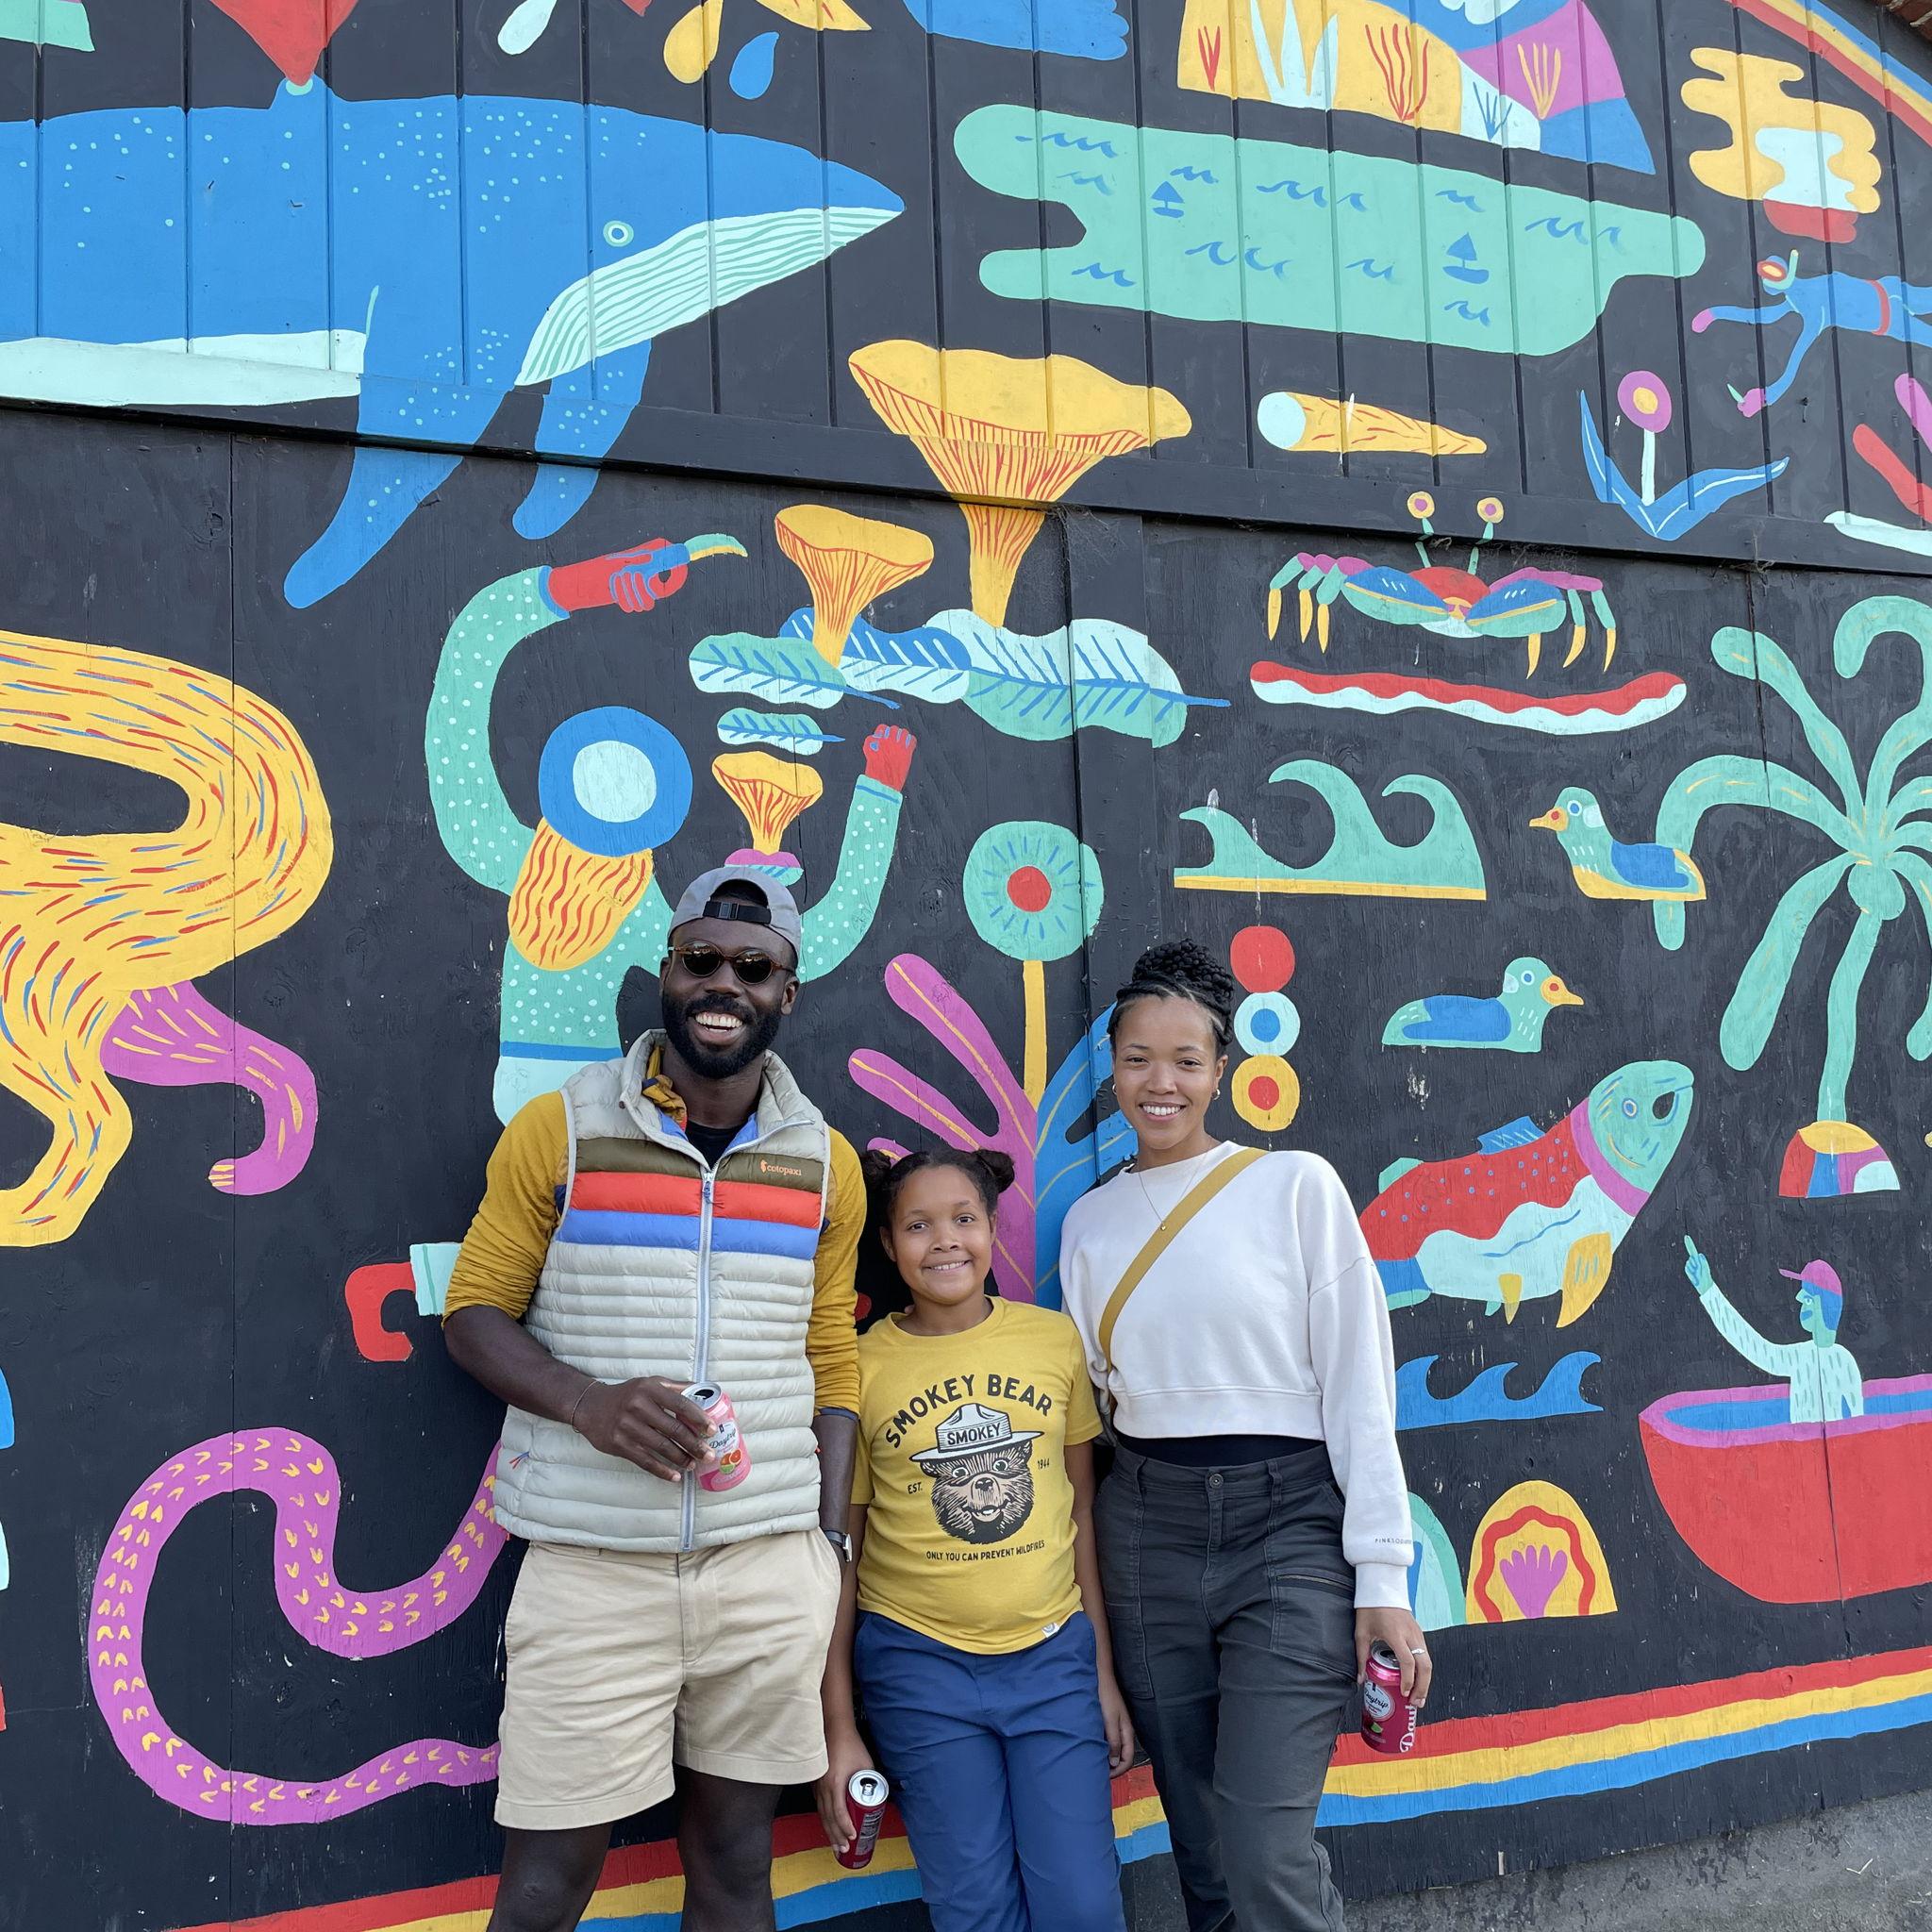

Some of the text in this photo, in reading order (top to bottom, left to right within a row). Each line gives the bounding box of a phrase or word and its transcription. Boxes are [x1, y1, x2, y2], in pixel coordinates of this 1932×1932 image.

[766, 1164, 802, 1176] cotopaxi
[885, 1374, 1053, 1449] SMOKEY BEAR
[947, 1423, 1002, 1445] SMOKEY
[1038, 1458, 1050, 1470] 1944
[926, 1540, 1045, 1561] ONLY YOU CAN PREVENT WILDFIRES
